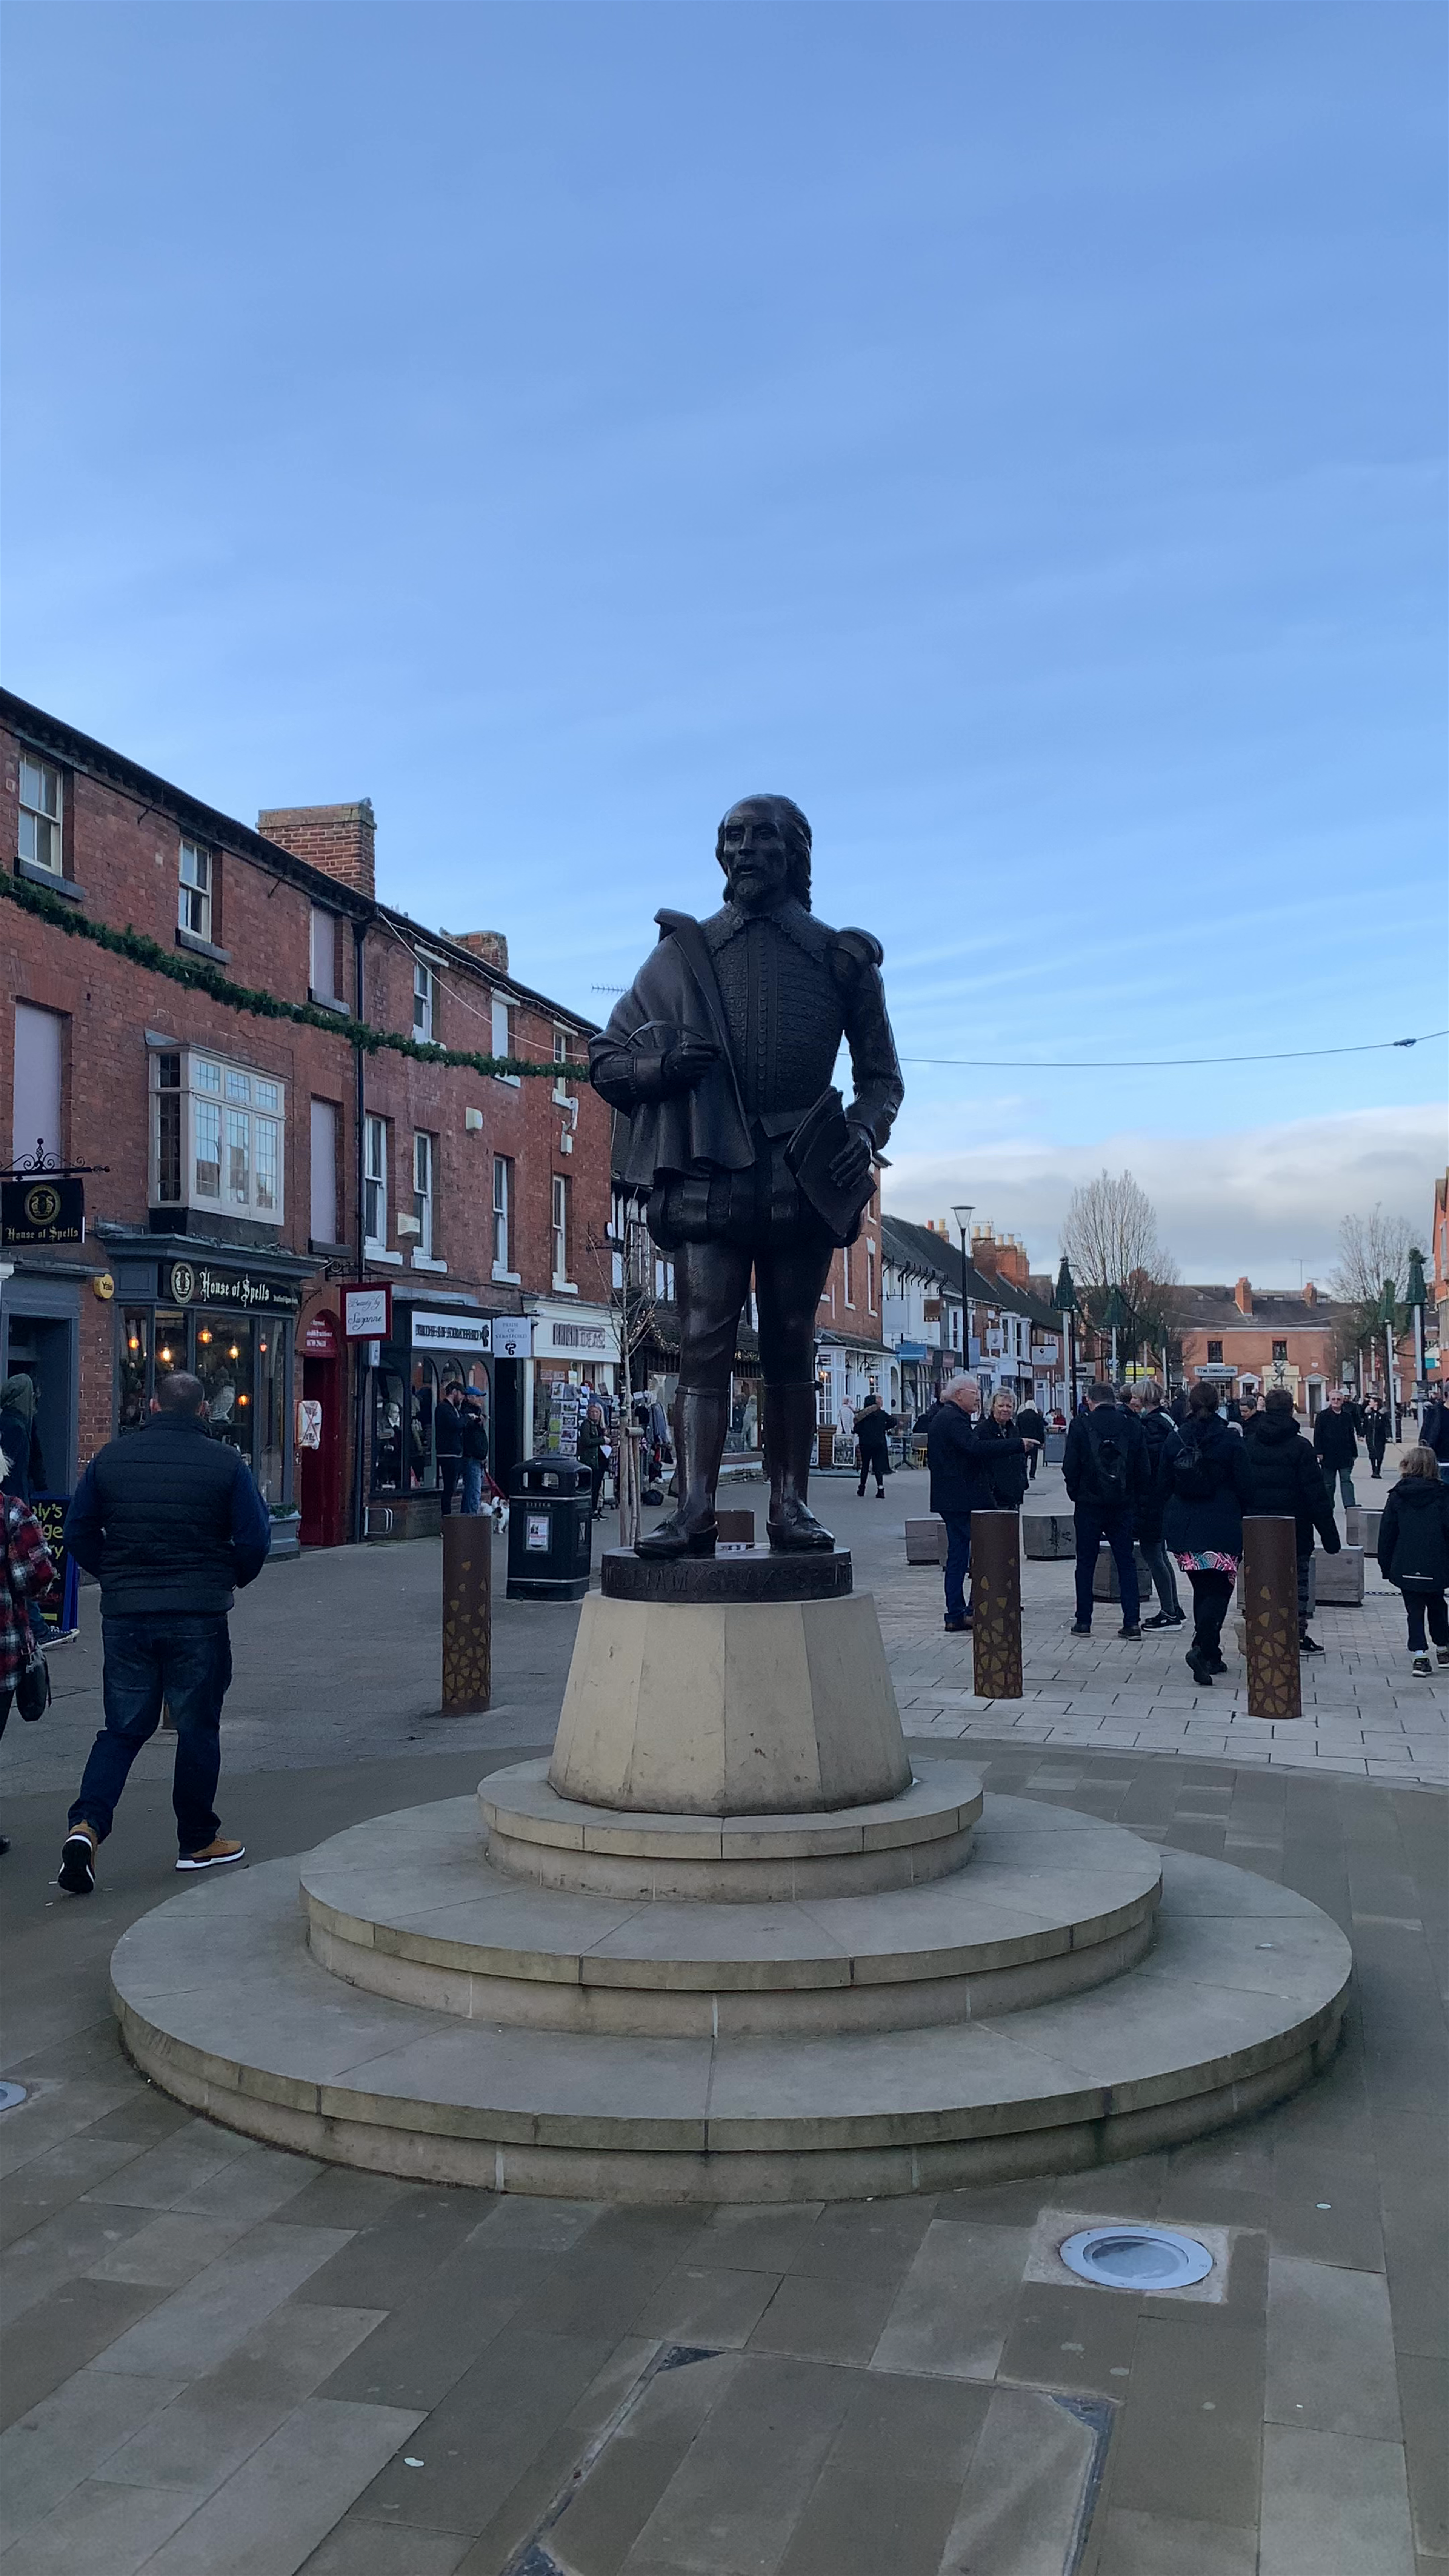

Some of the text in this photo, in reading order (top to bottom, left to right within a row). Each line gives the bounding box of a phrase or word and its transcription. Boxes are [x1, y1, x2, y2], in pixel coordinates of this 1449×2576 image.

[5, 1227, 35, 1242] House
[49, 1226, 78, 1242] Spells
[199, 1267, 269, 1307] House of Spells
[348, 1312, 383, 1331] Suzanne
